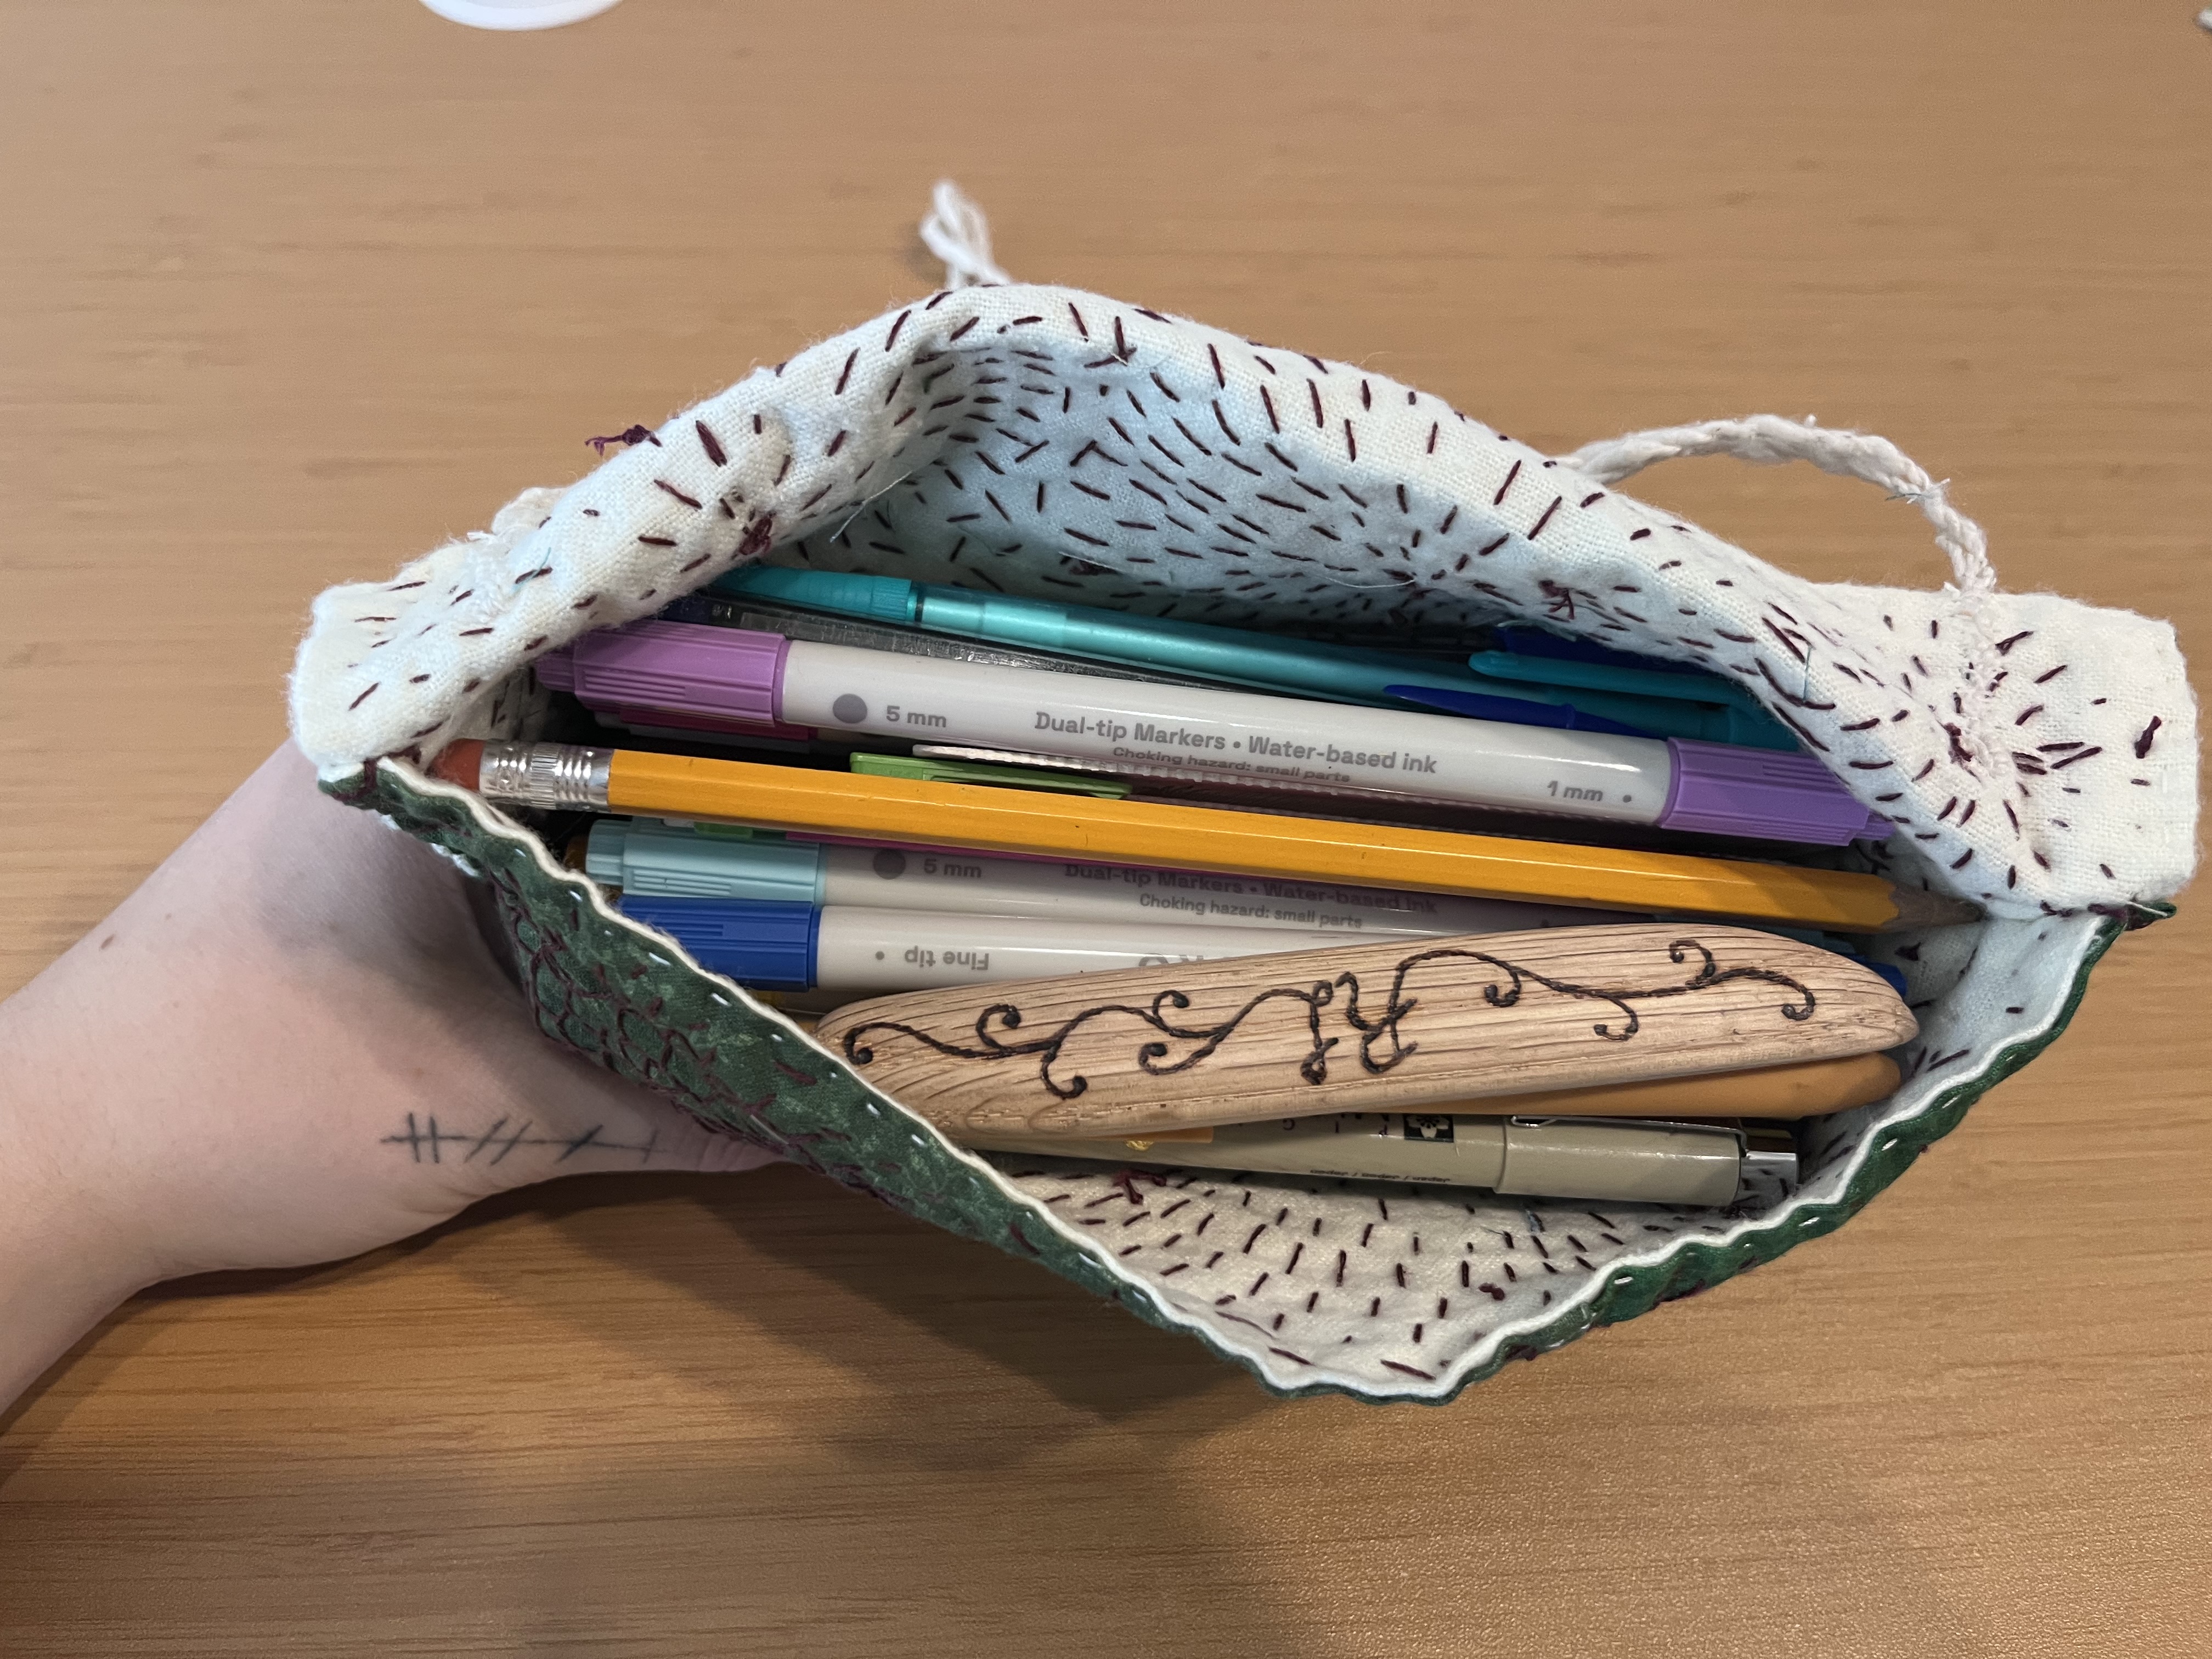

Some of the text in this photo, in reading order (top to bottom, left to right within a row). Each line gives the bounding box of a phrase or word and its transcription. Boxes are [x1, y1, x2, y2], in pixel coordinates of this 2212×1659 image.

[886, 706, 947, 728] 5 mm
[1035, 712, 1438, 774] Dual-tip Markers Water-based ink
[1112, 747, 1351, 783] Choking hazard: small parts
[1547, 780, 1604, 802] 1 mm
[923, 859, 982, 879] 5 mm
[1065, 864, 1151, 888] Dual-tip
[1158, 872, 1244, 894] Markers
[1264, 883, 1399, 907] Water-based
[1139, 893, 1363, 929] Choking hazard: small parts
[905, 945, 990, 970] Fine tip
